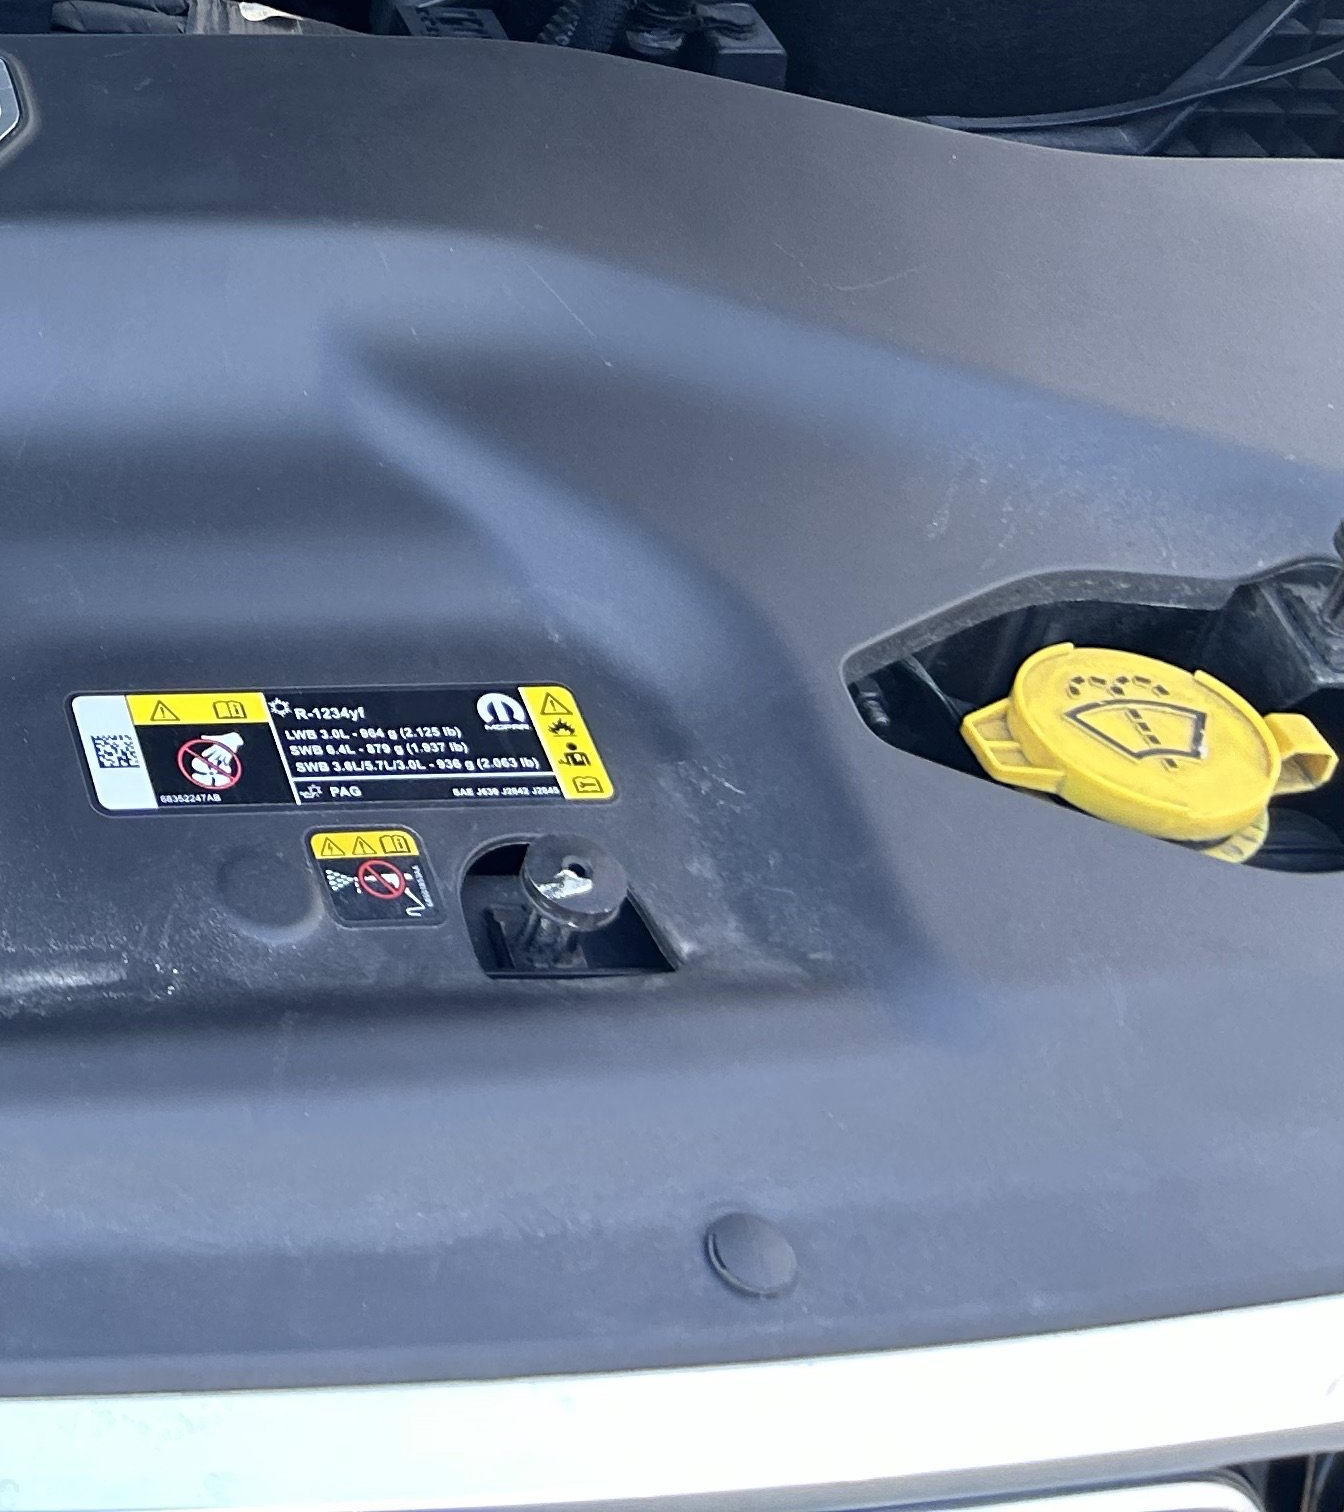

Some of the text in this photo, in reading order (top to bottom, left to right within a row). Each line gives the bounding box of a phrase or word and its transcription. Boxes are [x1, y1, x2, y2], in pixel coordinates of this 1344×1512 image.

[293, 706, 366, 722] R-1234yf
[285, 729, 318, 741] LWB
[320, 728, 350, 740] 3.0L
[399, 726, 441, 740] (2.125
[442, 726, 462, 739] lb)
[289, 744, 324, 756] SWB
[448, 741, 470, 755] lb)
[295, 761, 330, 773] SWB
[519, 757, 541, 770] lb)
[330, 786, 362, 797] PAG
